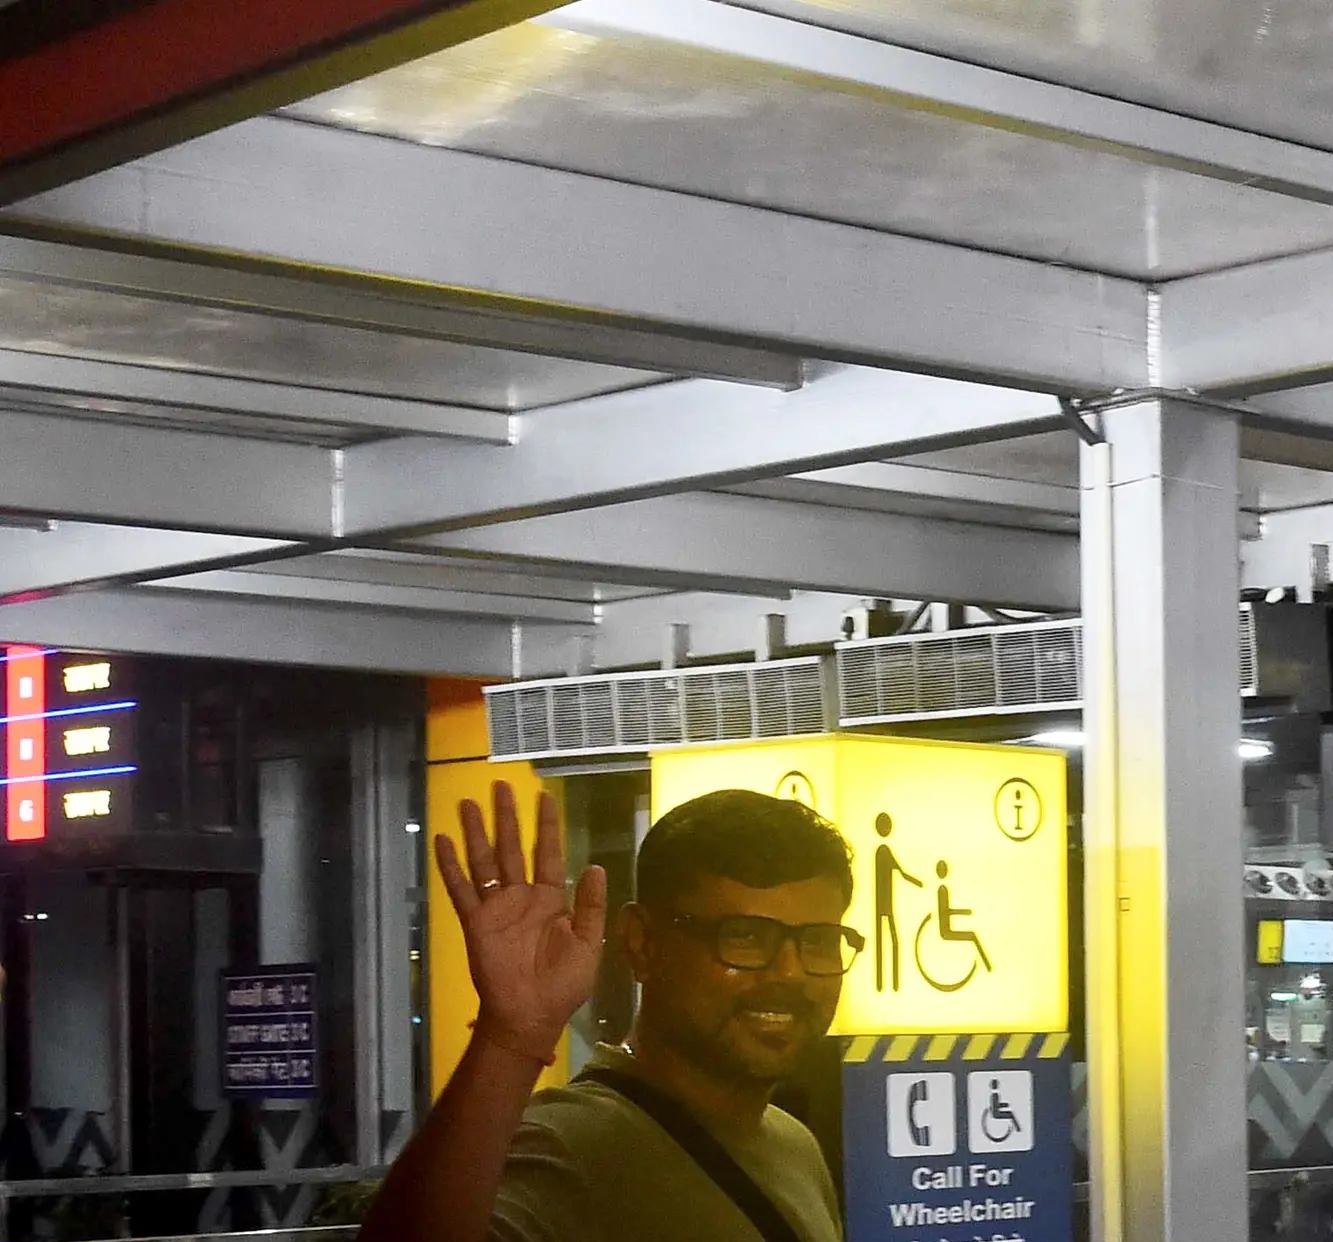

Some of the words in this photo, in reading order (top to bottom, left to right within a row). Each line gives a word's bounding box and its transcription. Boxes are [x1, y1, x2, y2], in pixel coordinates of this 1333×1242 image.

[912, 1166, 964, 1190] Call
[968, 1164, 1014, 1187] For
[889, 1196, 1036, 1227] Wheelchair
